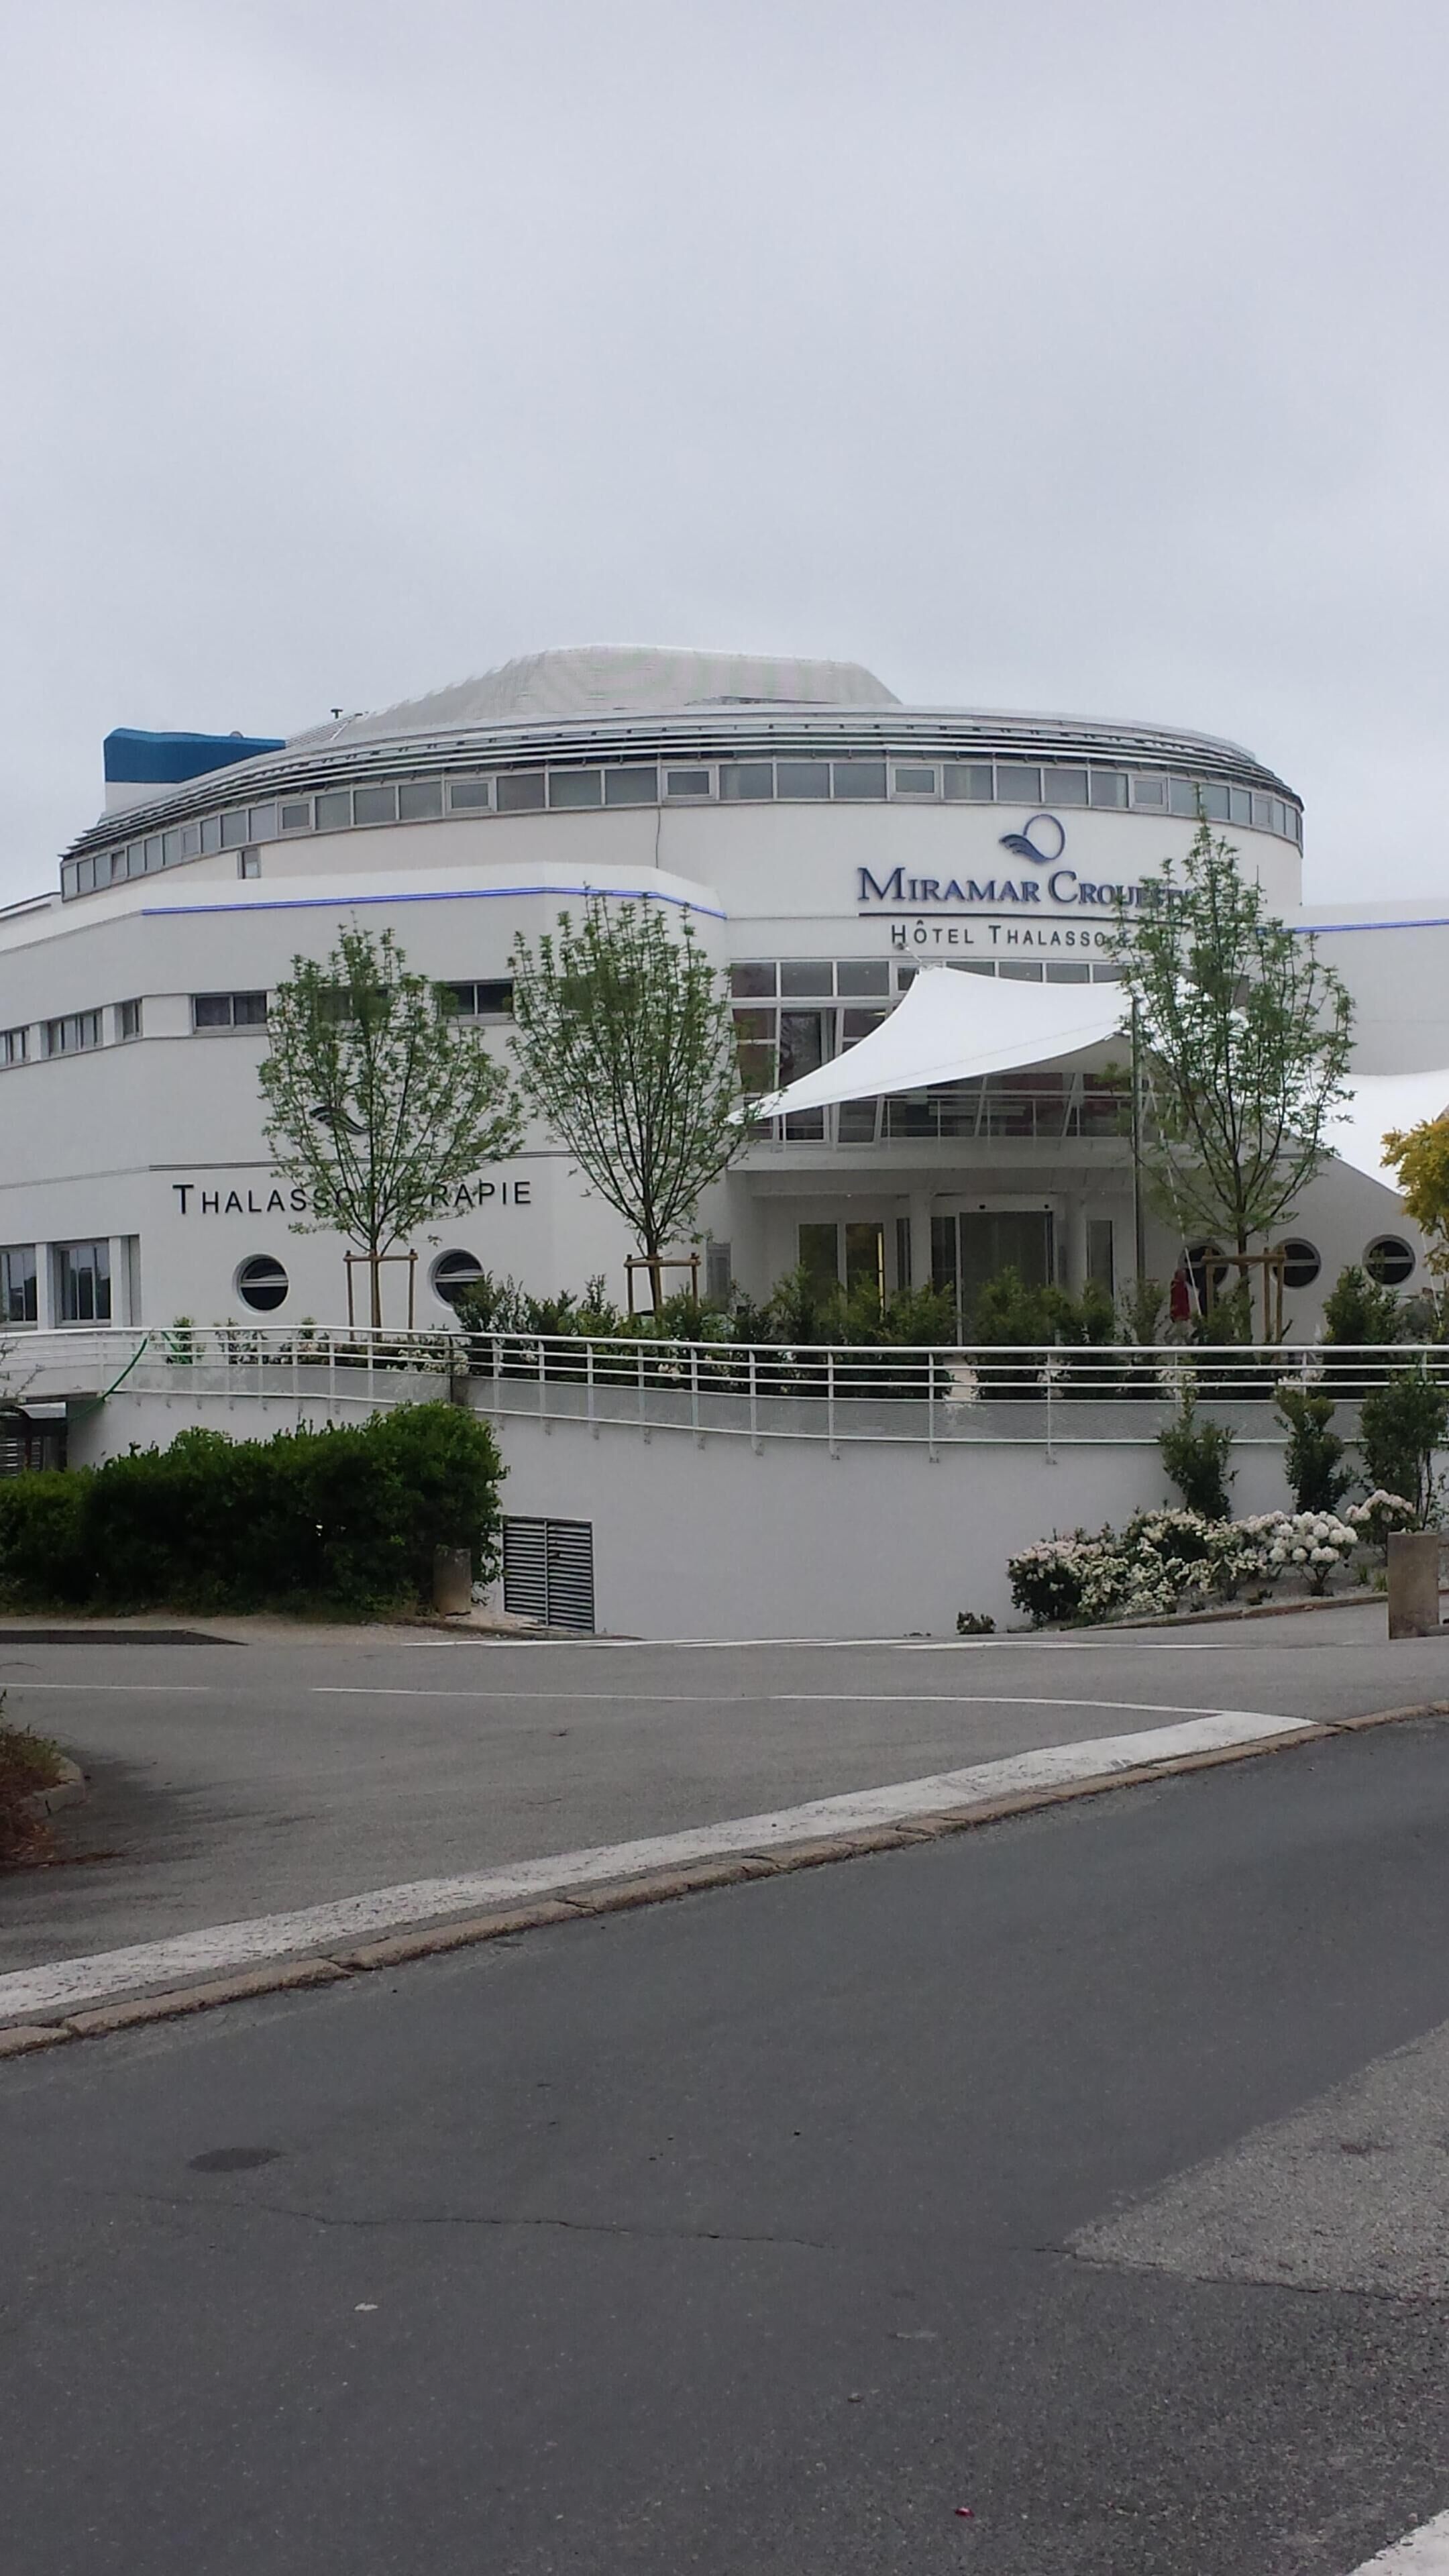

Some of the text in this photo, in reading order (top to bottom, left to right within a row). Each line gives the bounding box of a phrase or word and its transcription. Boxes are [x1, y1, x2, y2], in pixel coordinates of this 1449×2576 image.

[857, 867, 1040, 903] MIRAMAR
[891, 920, 974, 944] HÔTEL
[988, 924, 1106, 947] THALASSO
